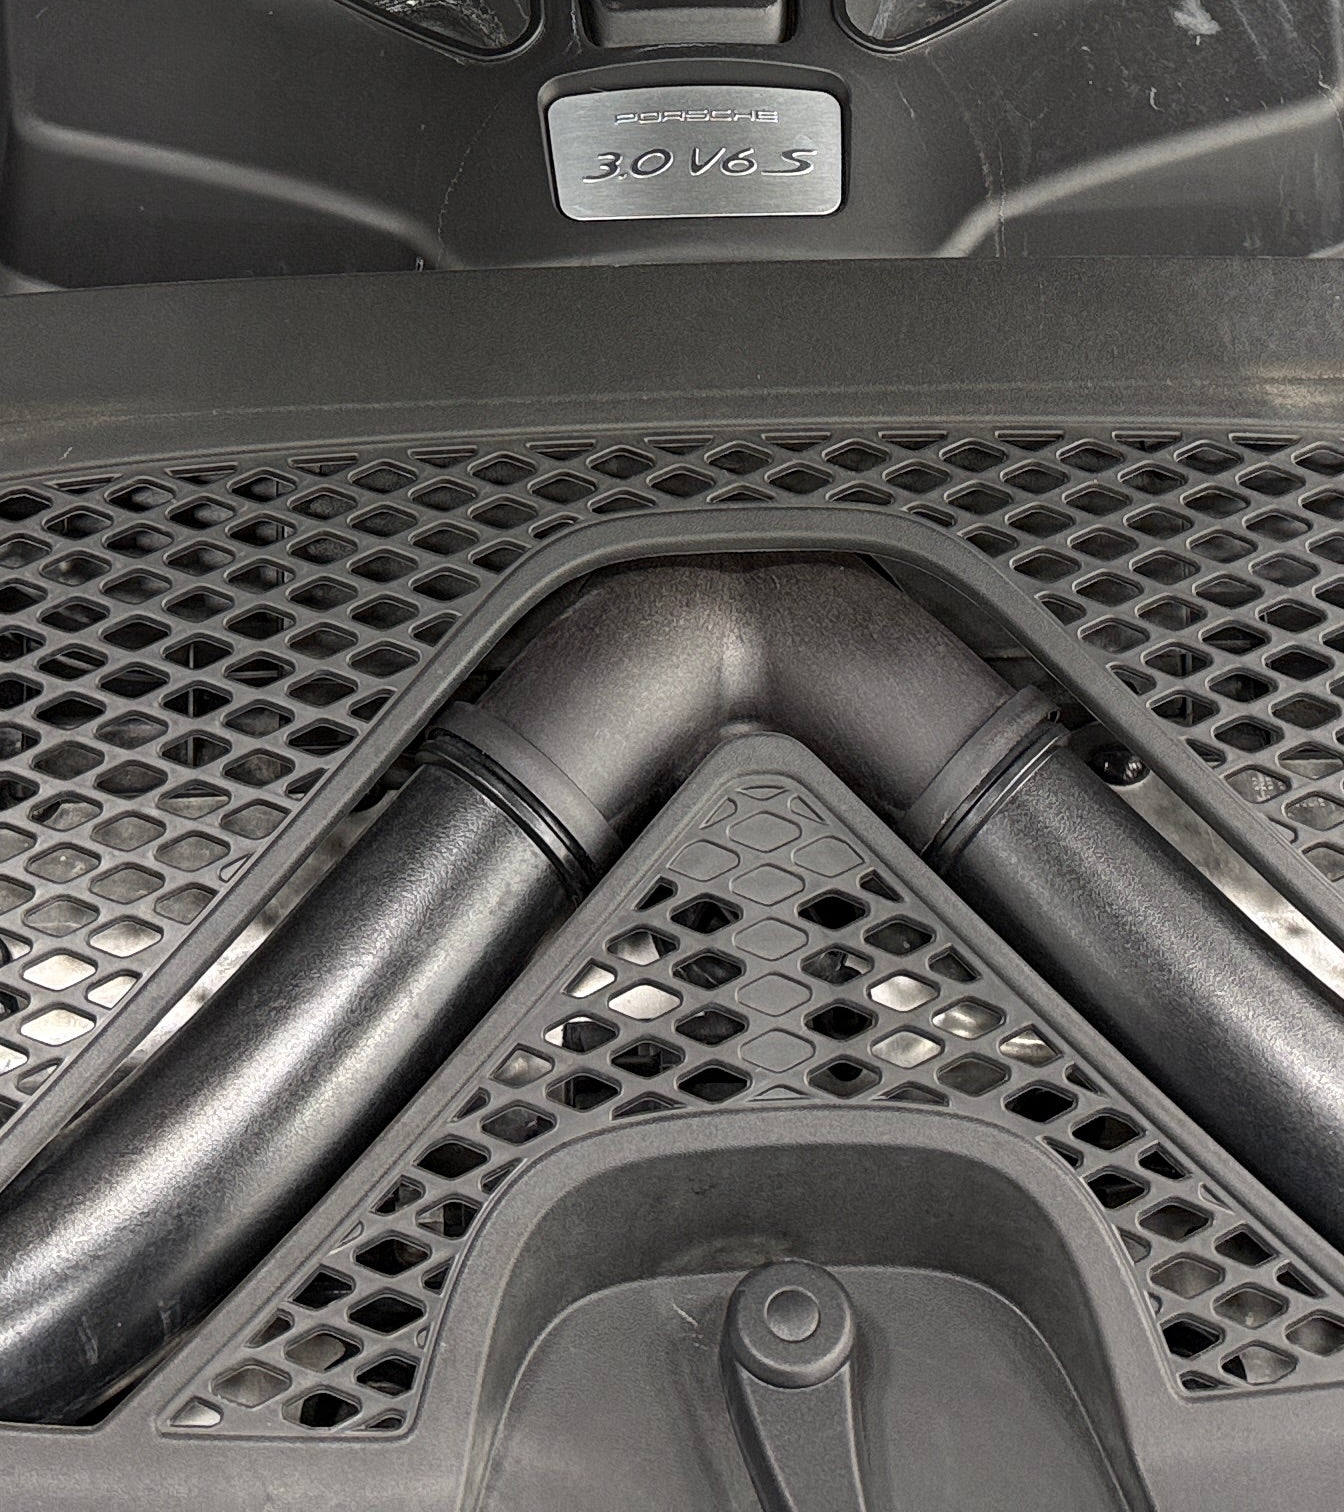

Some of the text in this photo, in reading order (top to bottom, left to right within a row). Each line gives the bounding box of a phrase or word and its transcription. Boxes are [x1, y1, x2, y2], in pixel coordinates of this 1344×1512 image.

[615, 109, 779, 125] PORSCHE
[582, 147, 818, 184] 3.0 V6 S
